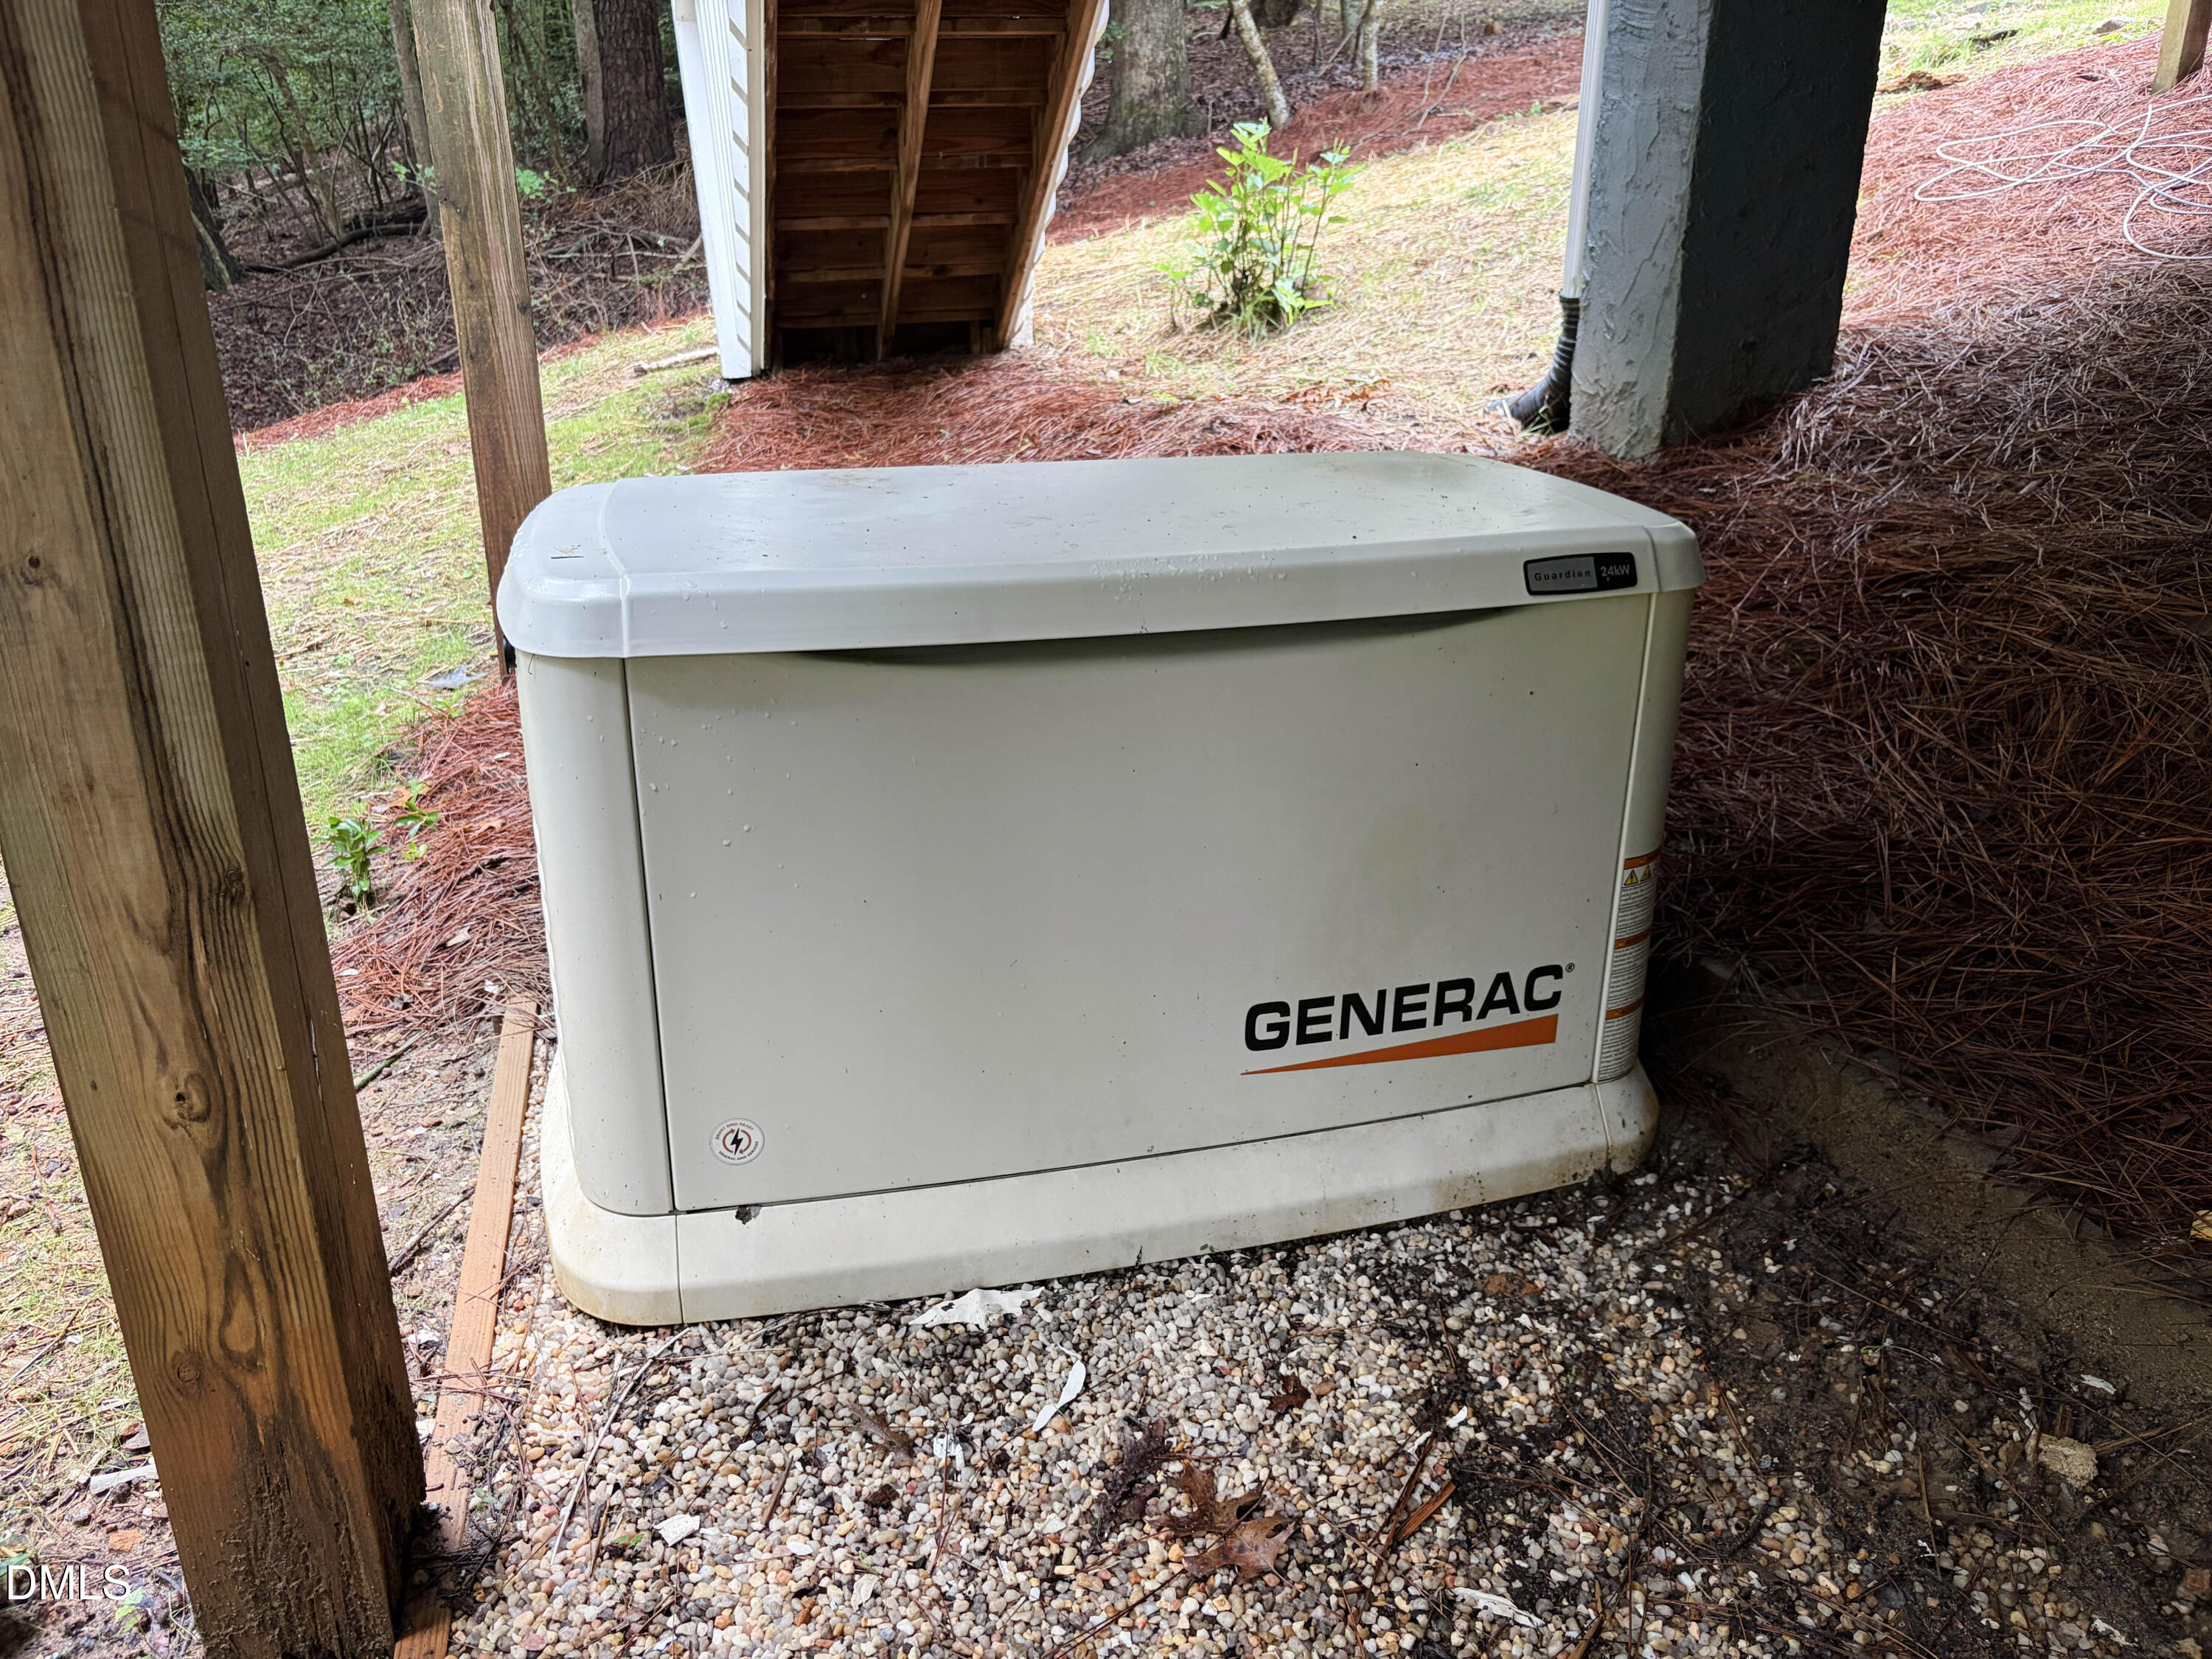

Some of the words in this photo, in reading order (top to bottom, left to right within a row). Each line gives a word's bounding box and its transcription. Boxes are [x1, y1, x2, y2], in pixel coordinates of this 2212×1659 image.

[1534, 569, 1591, 582] Guardian
[1600, 564, 1630, 577] 24kW
[1245, 964, 1564, 1051] GENERAC
